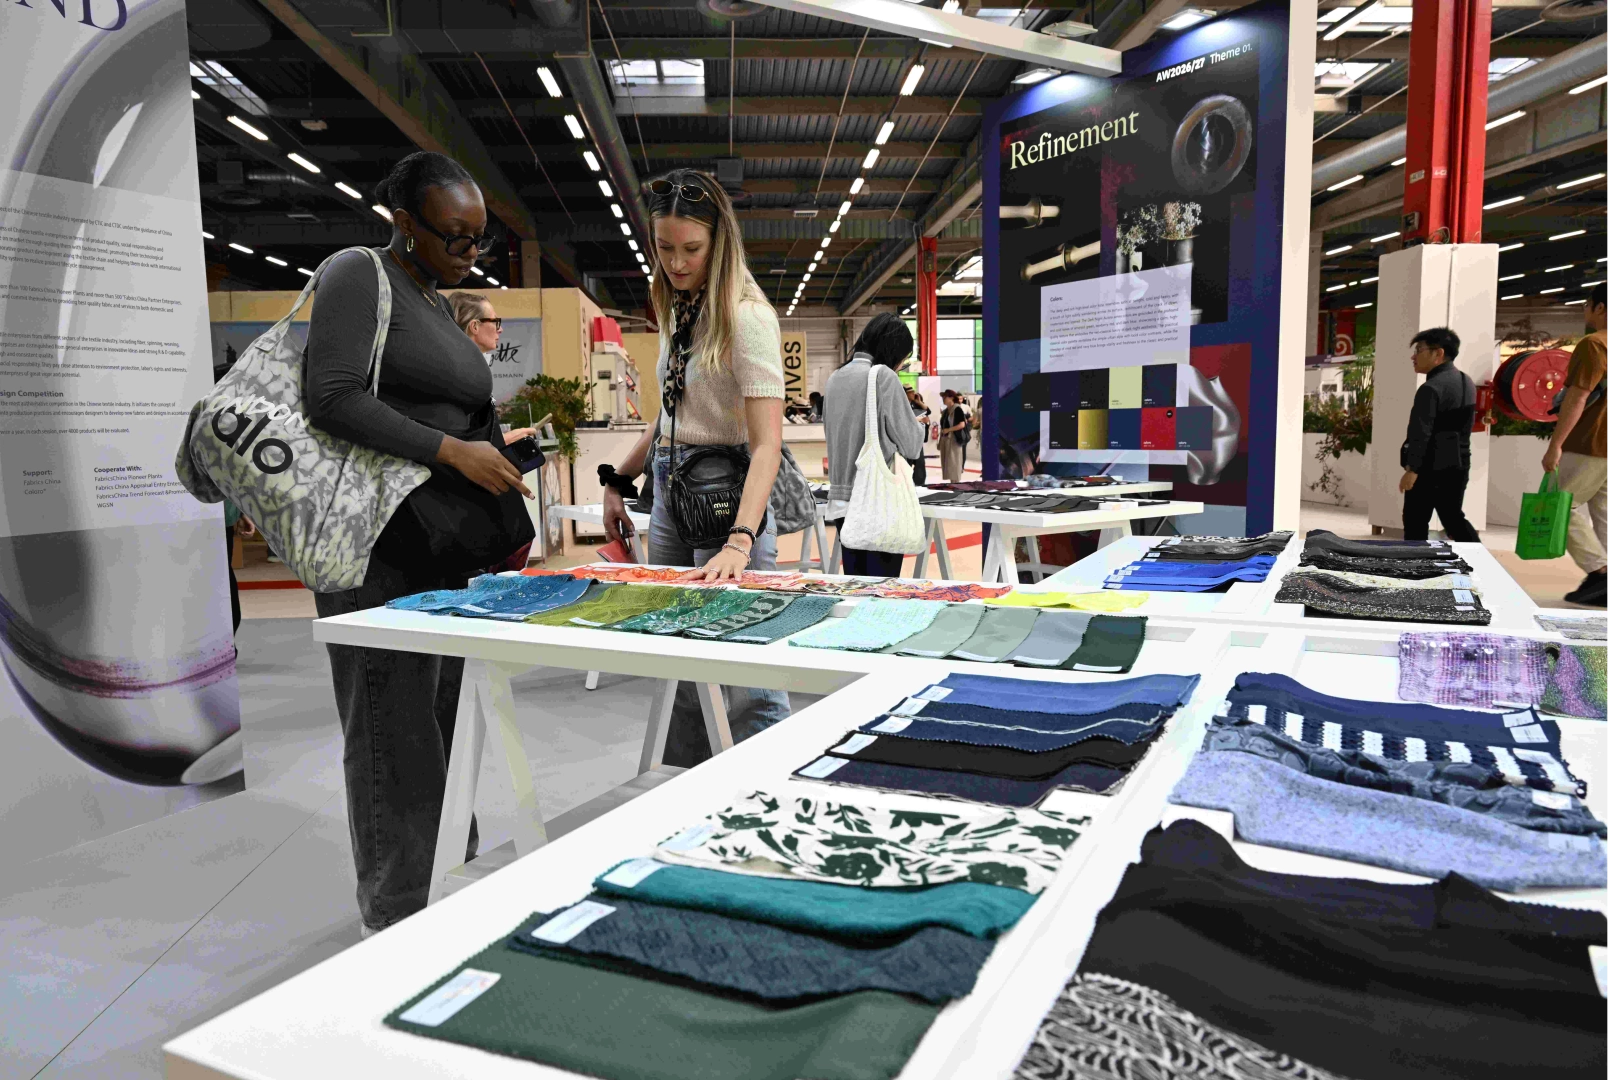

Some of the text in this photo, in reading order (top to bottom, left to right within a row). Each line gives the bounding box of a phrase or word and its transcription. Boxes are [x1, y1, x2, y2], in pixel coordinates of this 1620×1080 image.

[1156, 43, 1252, 82] AW2026/27 Theme 01.
[1010, 111, 1139, 170] Refinement
[18, 390, 64, 398] Competition
[212, 405, 293, 474] alo
[96, 492, 128, 500] FabricsChina
